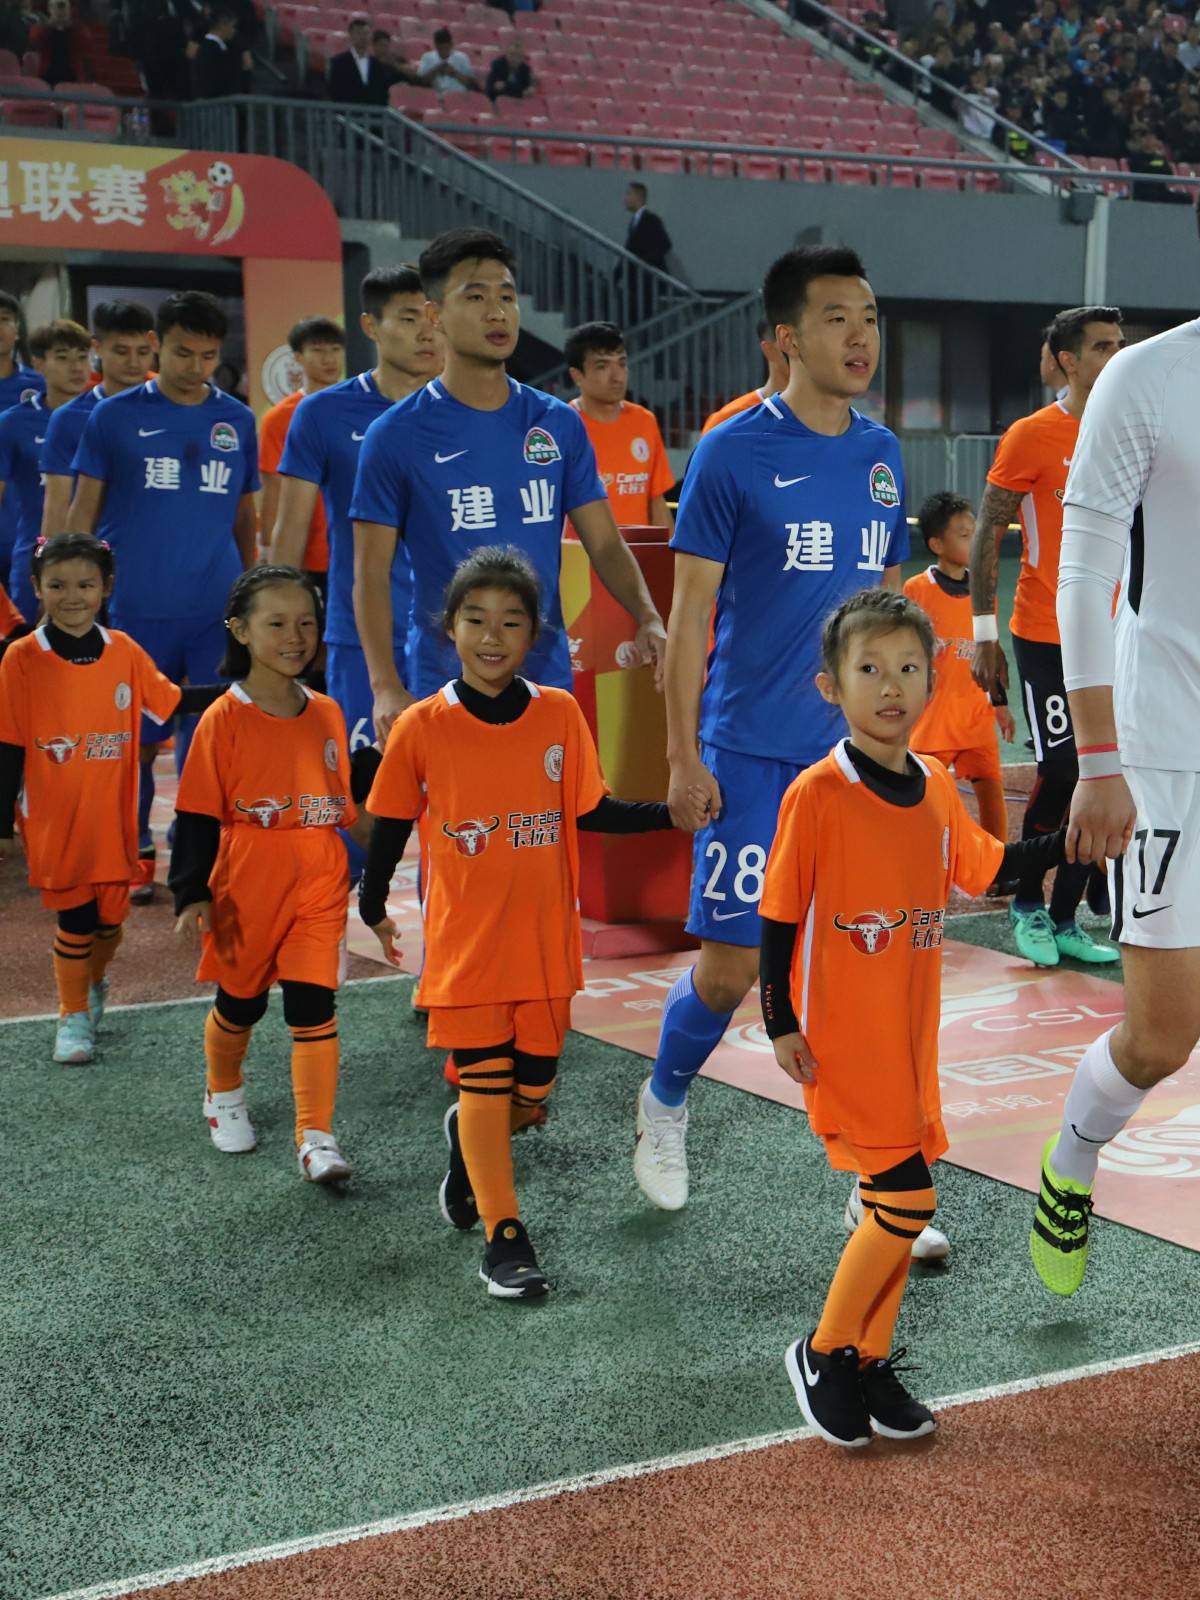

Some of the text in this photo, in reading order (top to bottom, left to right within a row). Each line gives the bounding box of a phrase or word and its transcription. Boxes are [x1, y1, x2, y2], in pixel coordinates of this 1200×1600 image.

[143, 456, 232, 494] 建业
[447, 478, 556, 532] 建业
[782, 520, 893, 571] 建业
[349, 717, 371, 754] 6
[1045, 694, 1069, 735] 8
[702, 841, 767, 903] 28
[1135, 829, 1181, 895] 17
[971, 1004, 1128, 1032] CSL
